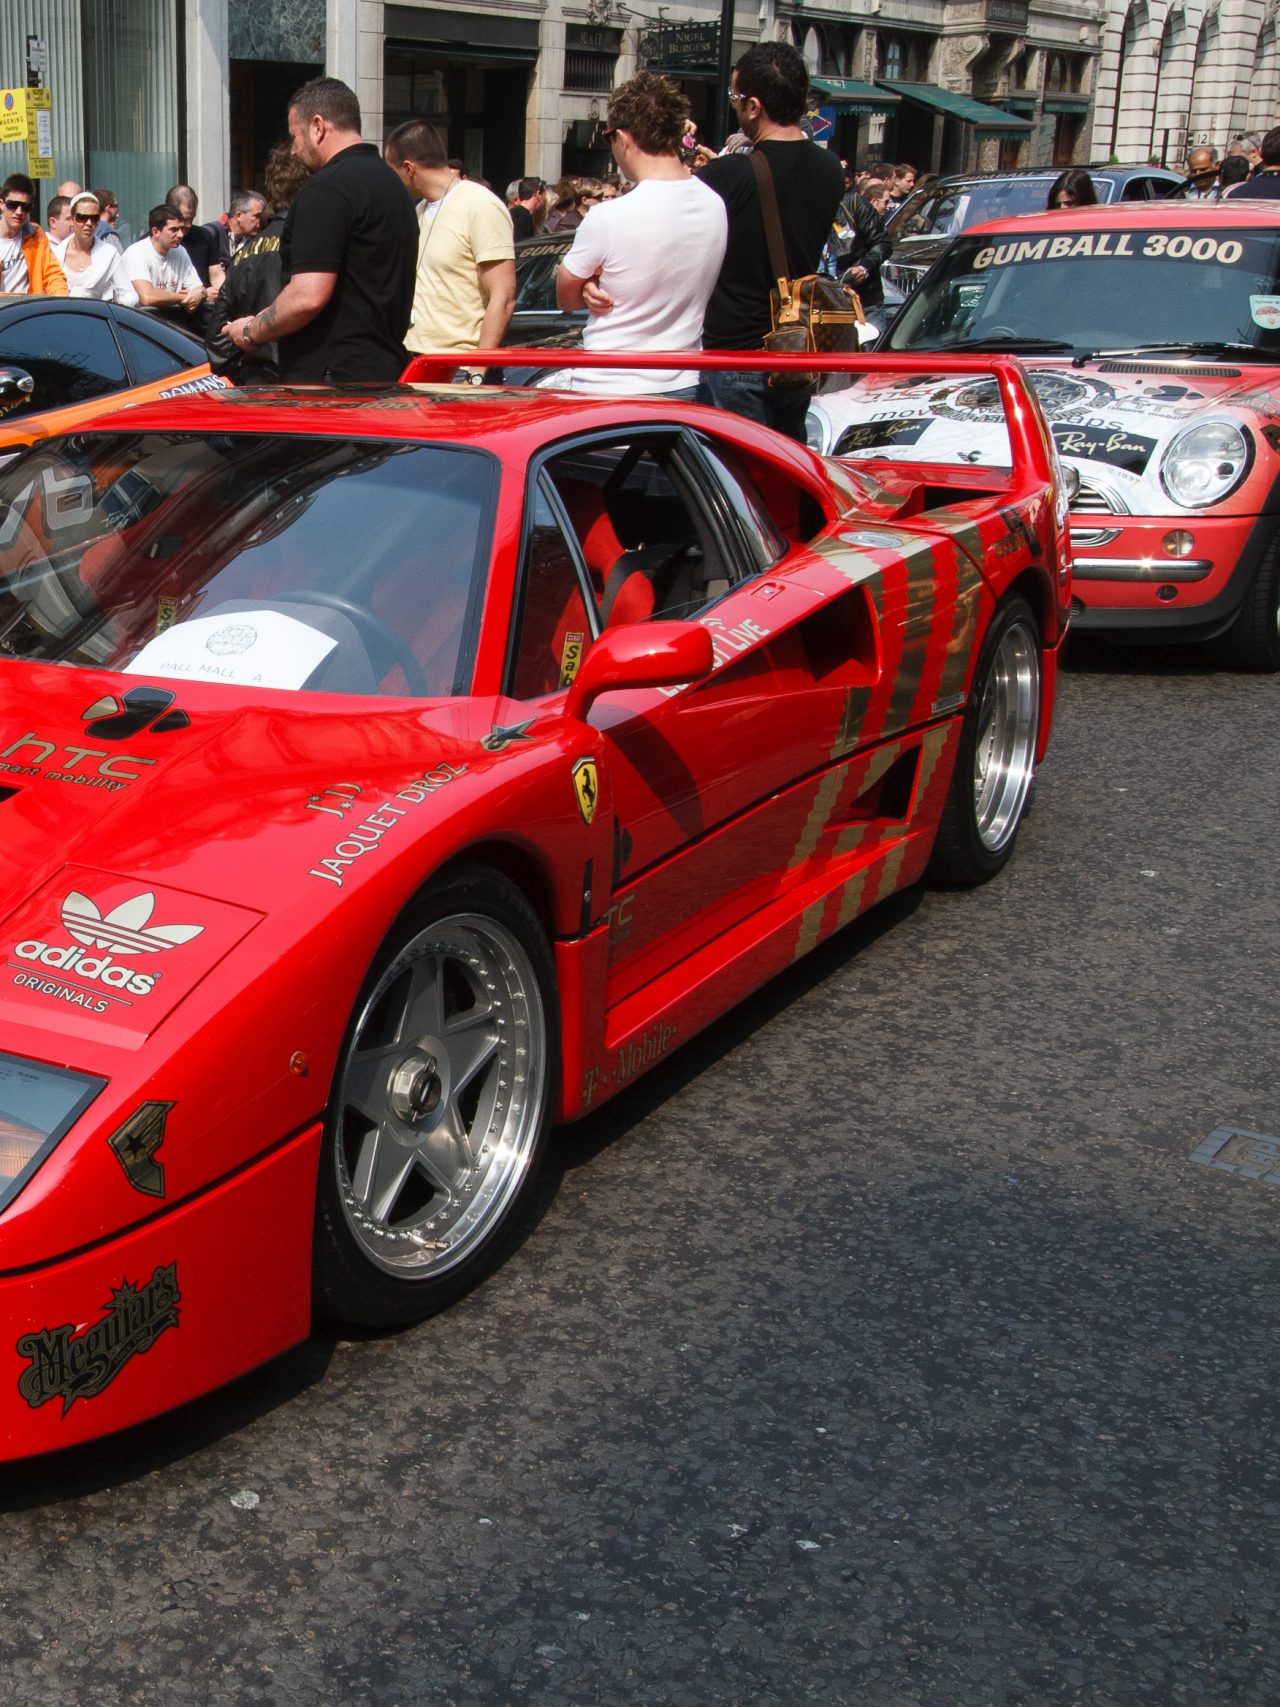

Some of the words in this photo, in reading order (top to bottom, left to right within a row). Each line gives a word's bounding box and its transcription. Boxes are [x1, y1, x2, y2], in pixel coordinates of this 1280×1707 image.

[669, 42, 711, 54] BURGESS
[676, 33, 705, 43] NIGEL
[0, 115, 24, 126] WARNING
[1197, 133, 1208, 144] 12
[972, 233, 1134, 271] GUMBALL
[1142, 233, 1245, 264] 3000
[160, 662, 193, 672] PALL
[198, 664, 236, 679] MALL
[44, 769, 129, 792] mobility
[308, 802, 410, 888] JAQUET
[395, 762, 469, 804] DROZ
[13, 938, 157, 996] adidas
[12, 972, 110, 1014] ORIGINALS
